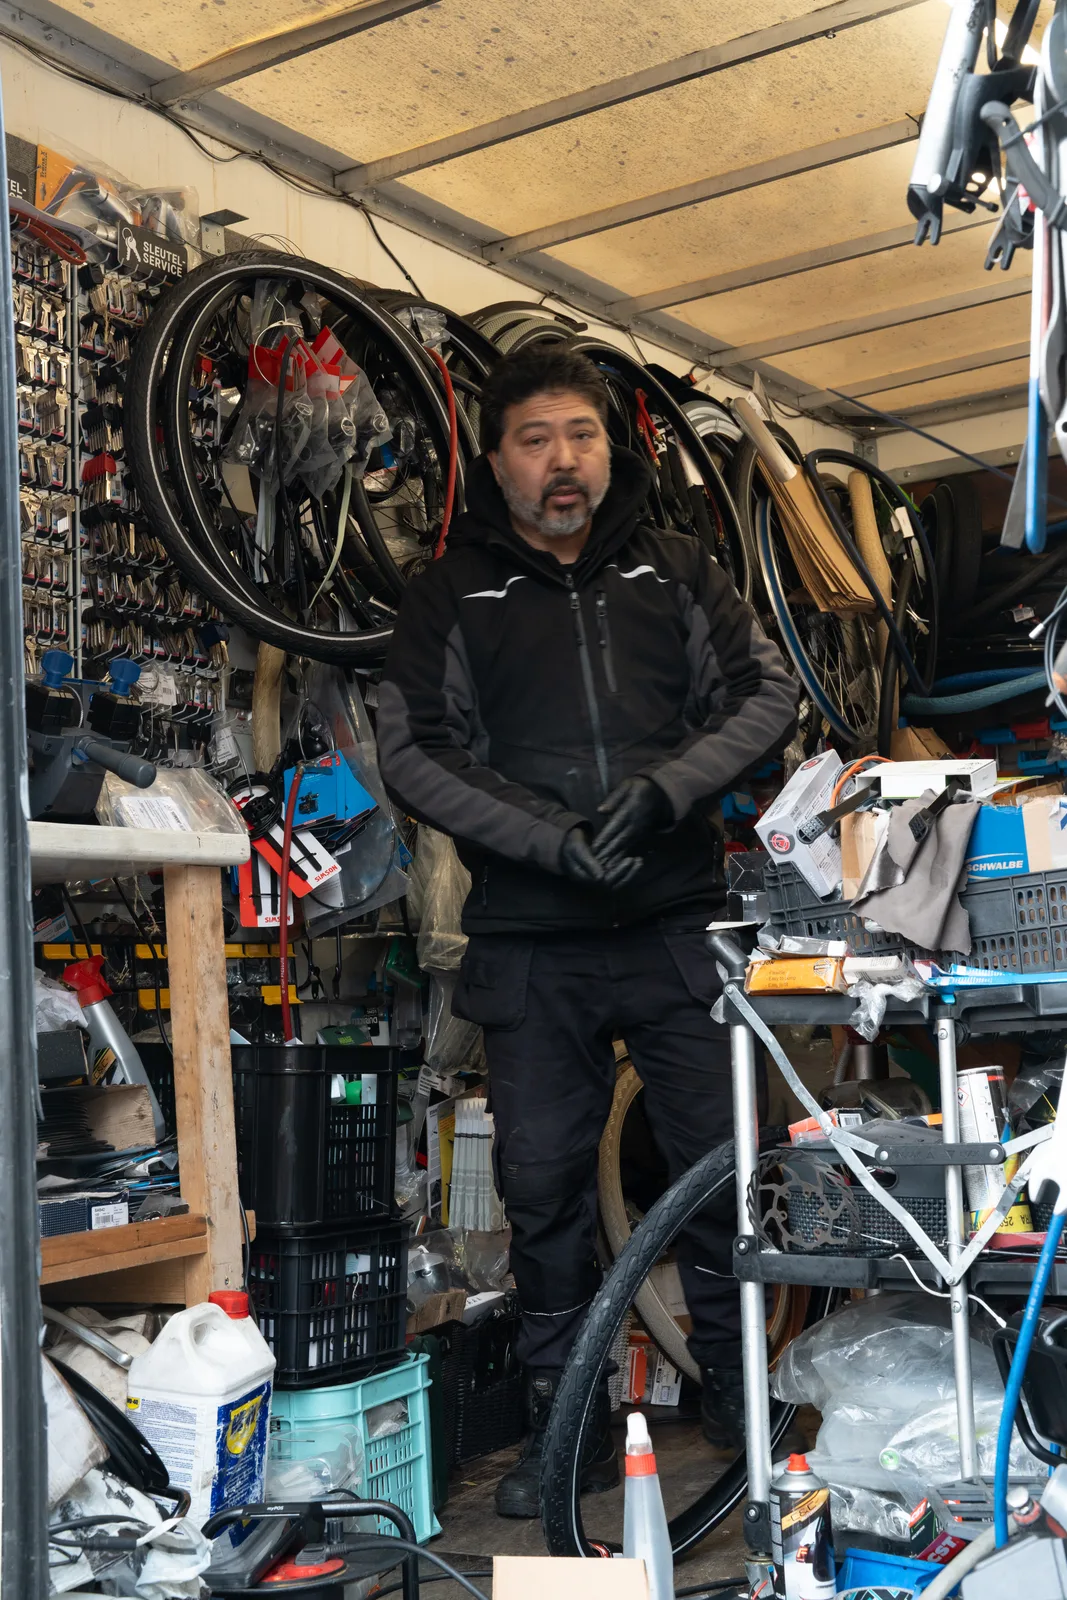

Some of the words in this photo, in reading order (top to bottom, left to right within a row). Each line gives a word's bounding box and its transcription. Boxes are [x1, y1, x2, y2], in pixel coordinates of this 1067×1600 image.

[7, 178, 27, 195] EL-
[143, 241, 186, 267] SLEUTEL-
[143, 254, 183, 278] SERVICE
[314, 864, 338, 883] SIMSON
[966, 860, 1024, 872] SCHWALBE
[264, 915, 291, 923] SIMSN
[790, 1500, 817, 1522] C&C
[926, 1535, 957, 1563] CST
